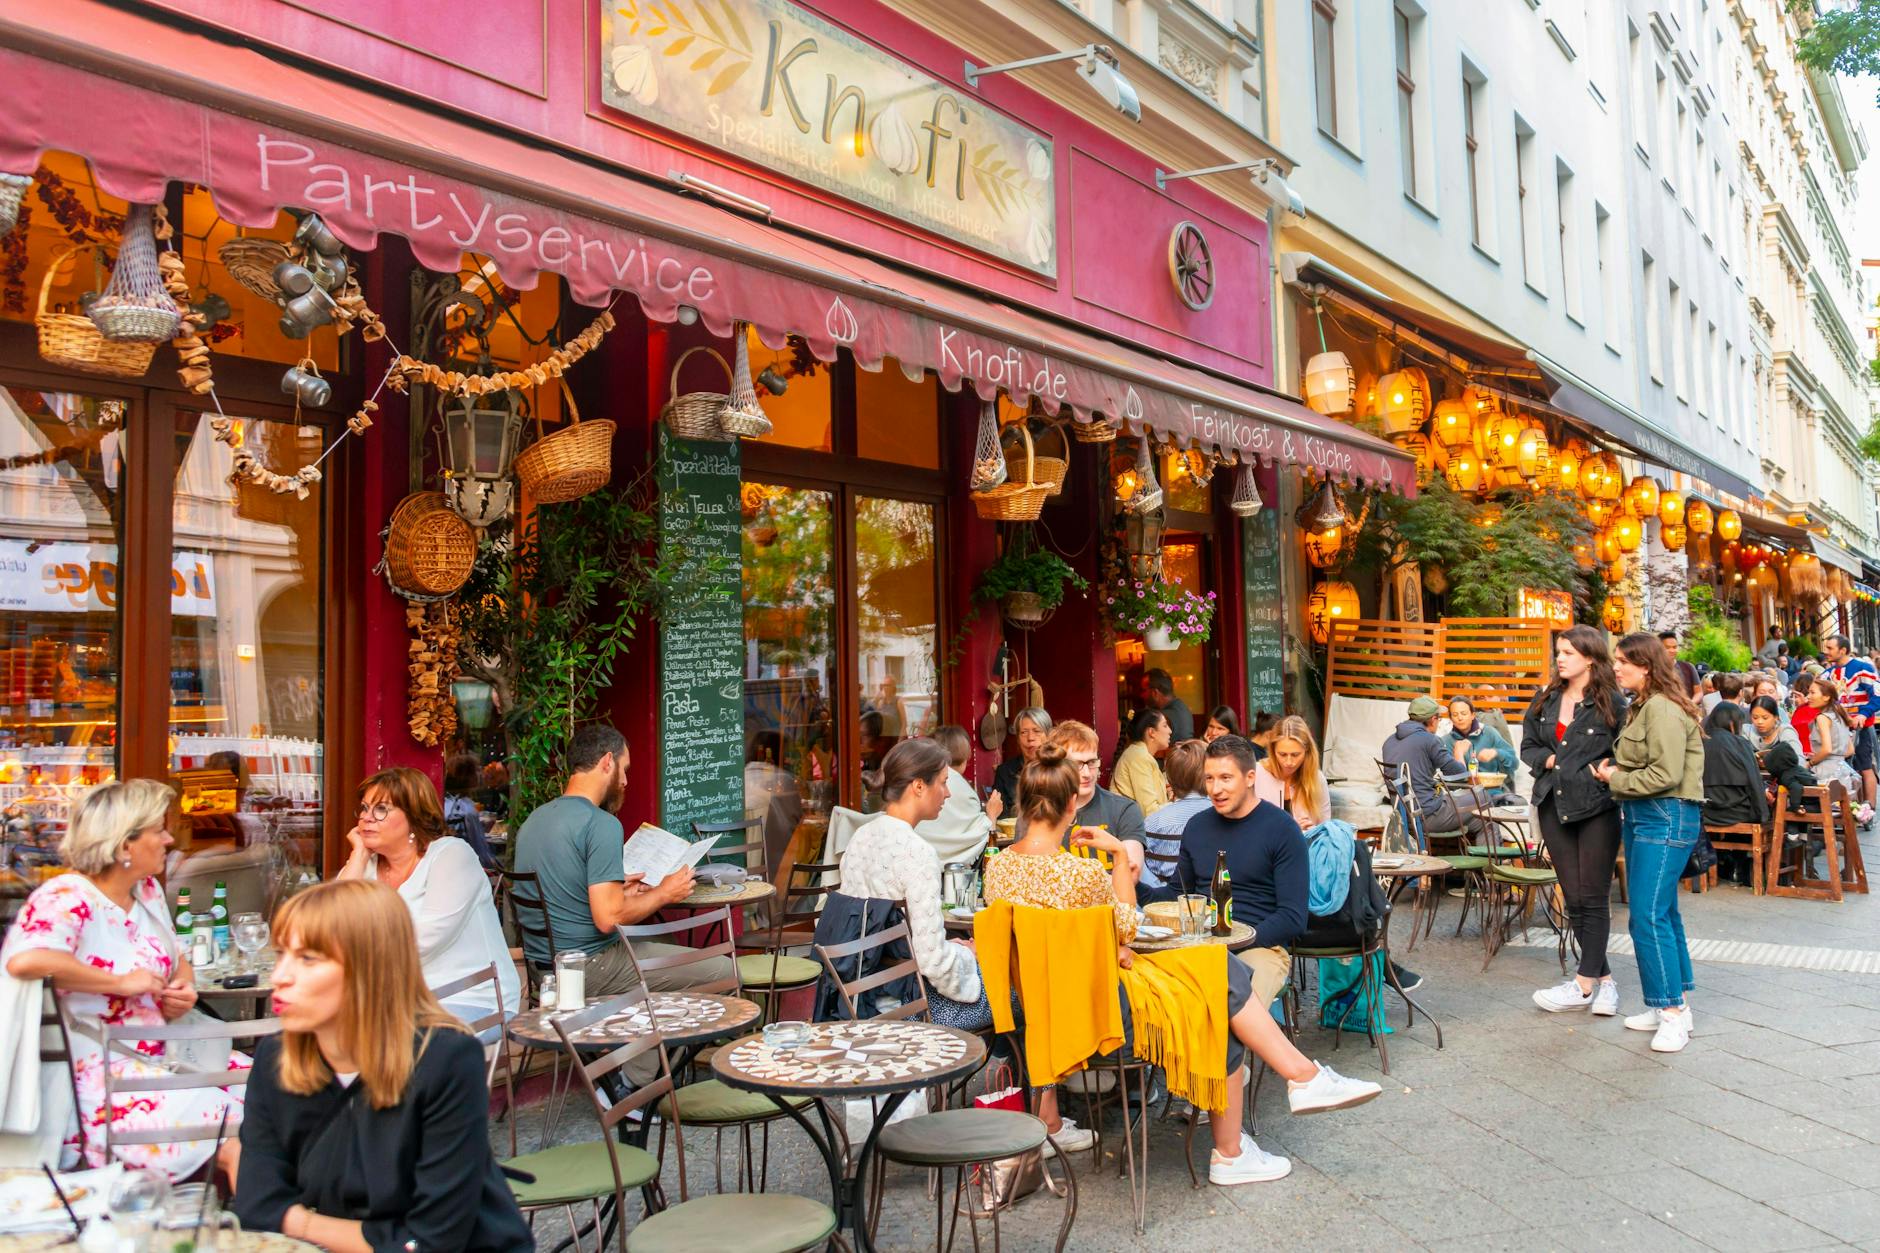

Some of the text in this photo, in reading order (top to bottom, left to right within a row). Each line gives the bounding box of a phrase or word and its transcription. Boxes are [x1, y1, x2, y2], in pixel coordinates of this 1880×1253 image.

[256, 133, 714, 302] Partyservice
[858, 169, 897, 203] vom
[912, 187, 999, 239] Mittelmeer
[939, 325, 1068, 399] Knofi.de
[1190, 402, 1353, 472] Feinkost & Küche
[662, 691, 701, 717] Pasta
[665, 716, 687, 731] Penne
